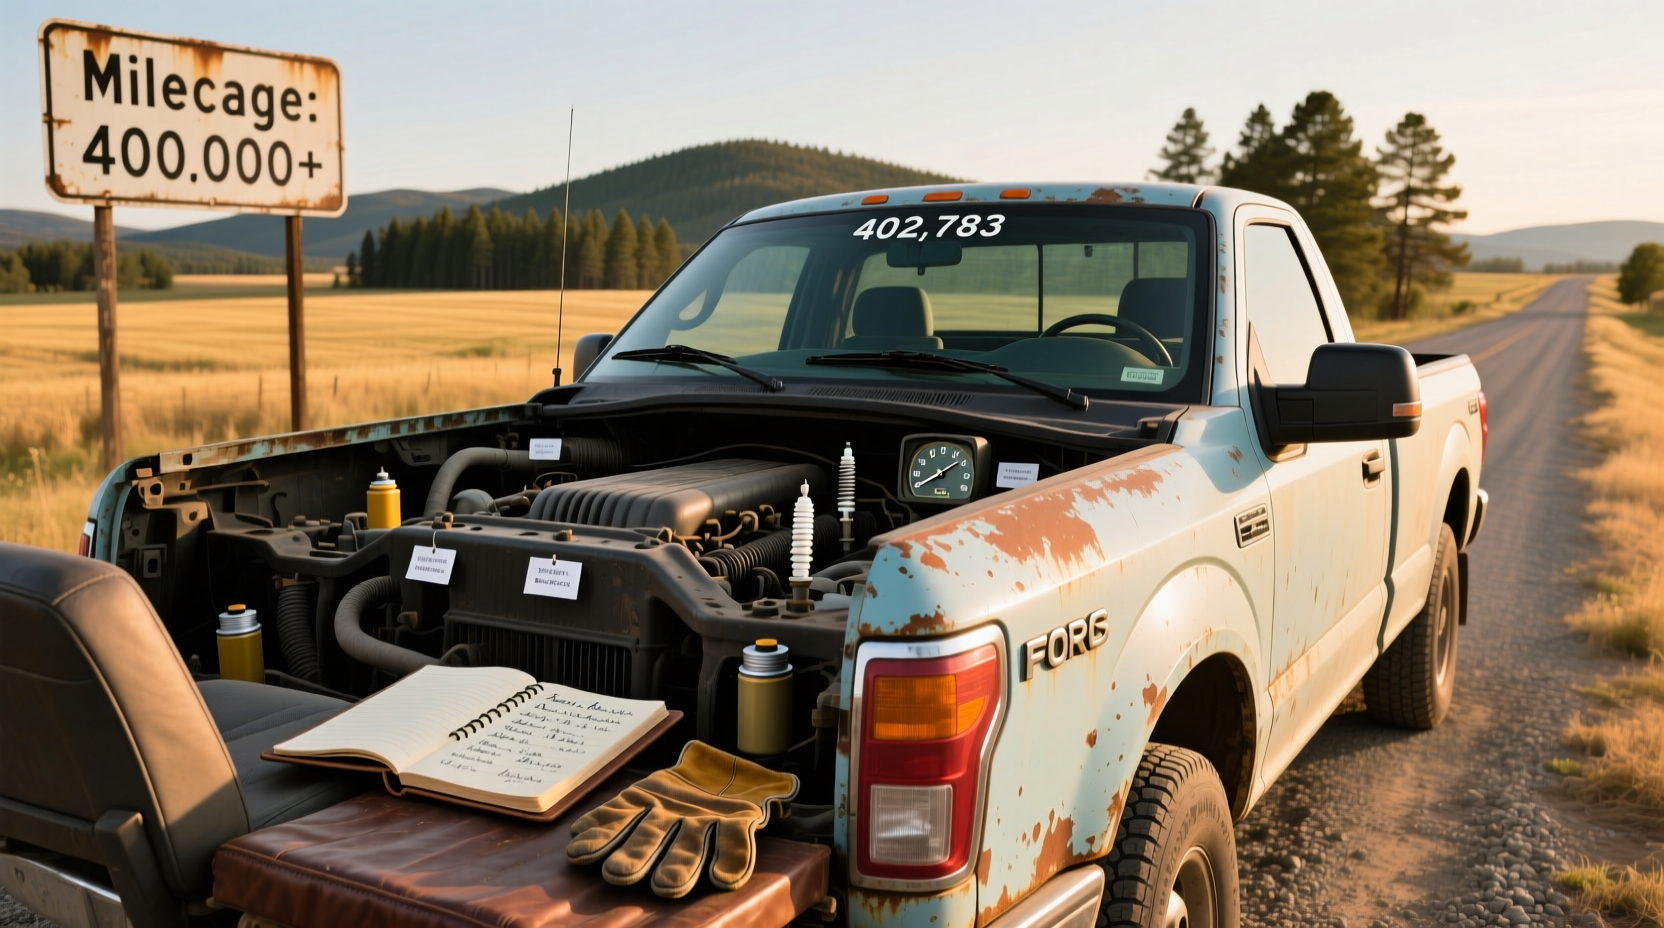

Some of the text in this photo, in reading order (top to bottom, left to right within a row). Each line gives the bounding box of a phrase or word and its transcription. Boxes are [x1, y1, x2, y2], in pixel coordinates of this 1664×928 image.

[83, 49, 317, 131] Milecage:
[82, 125, 322, 186] 400.000+
[852, 214, 1006, 242] 402,783
